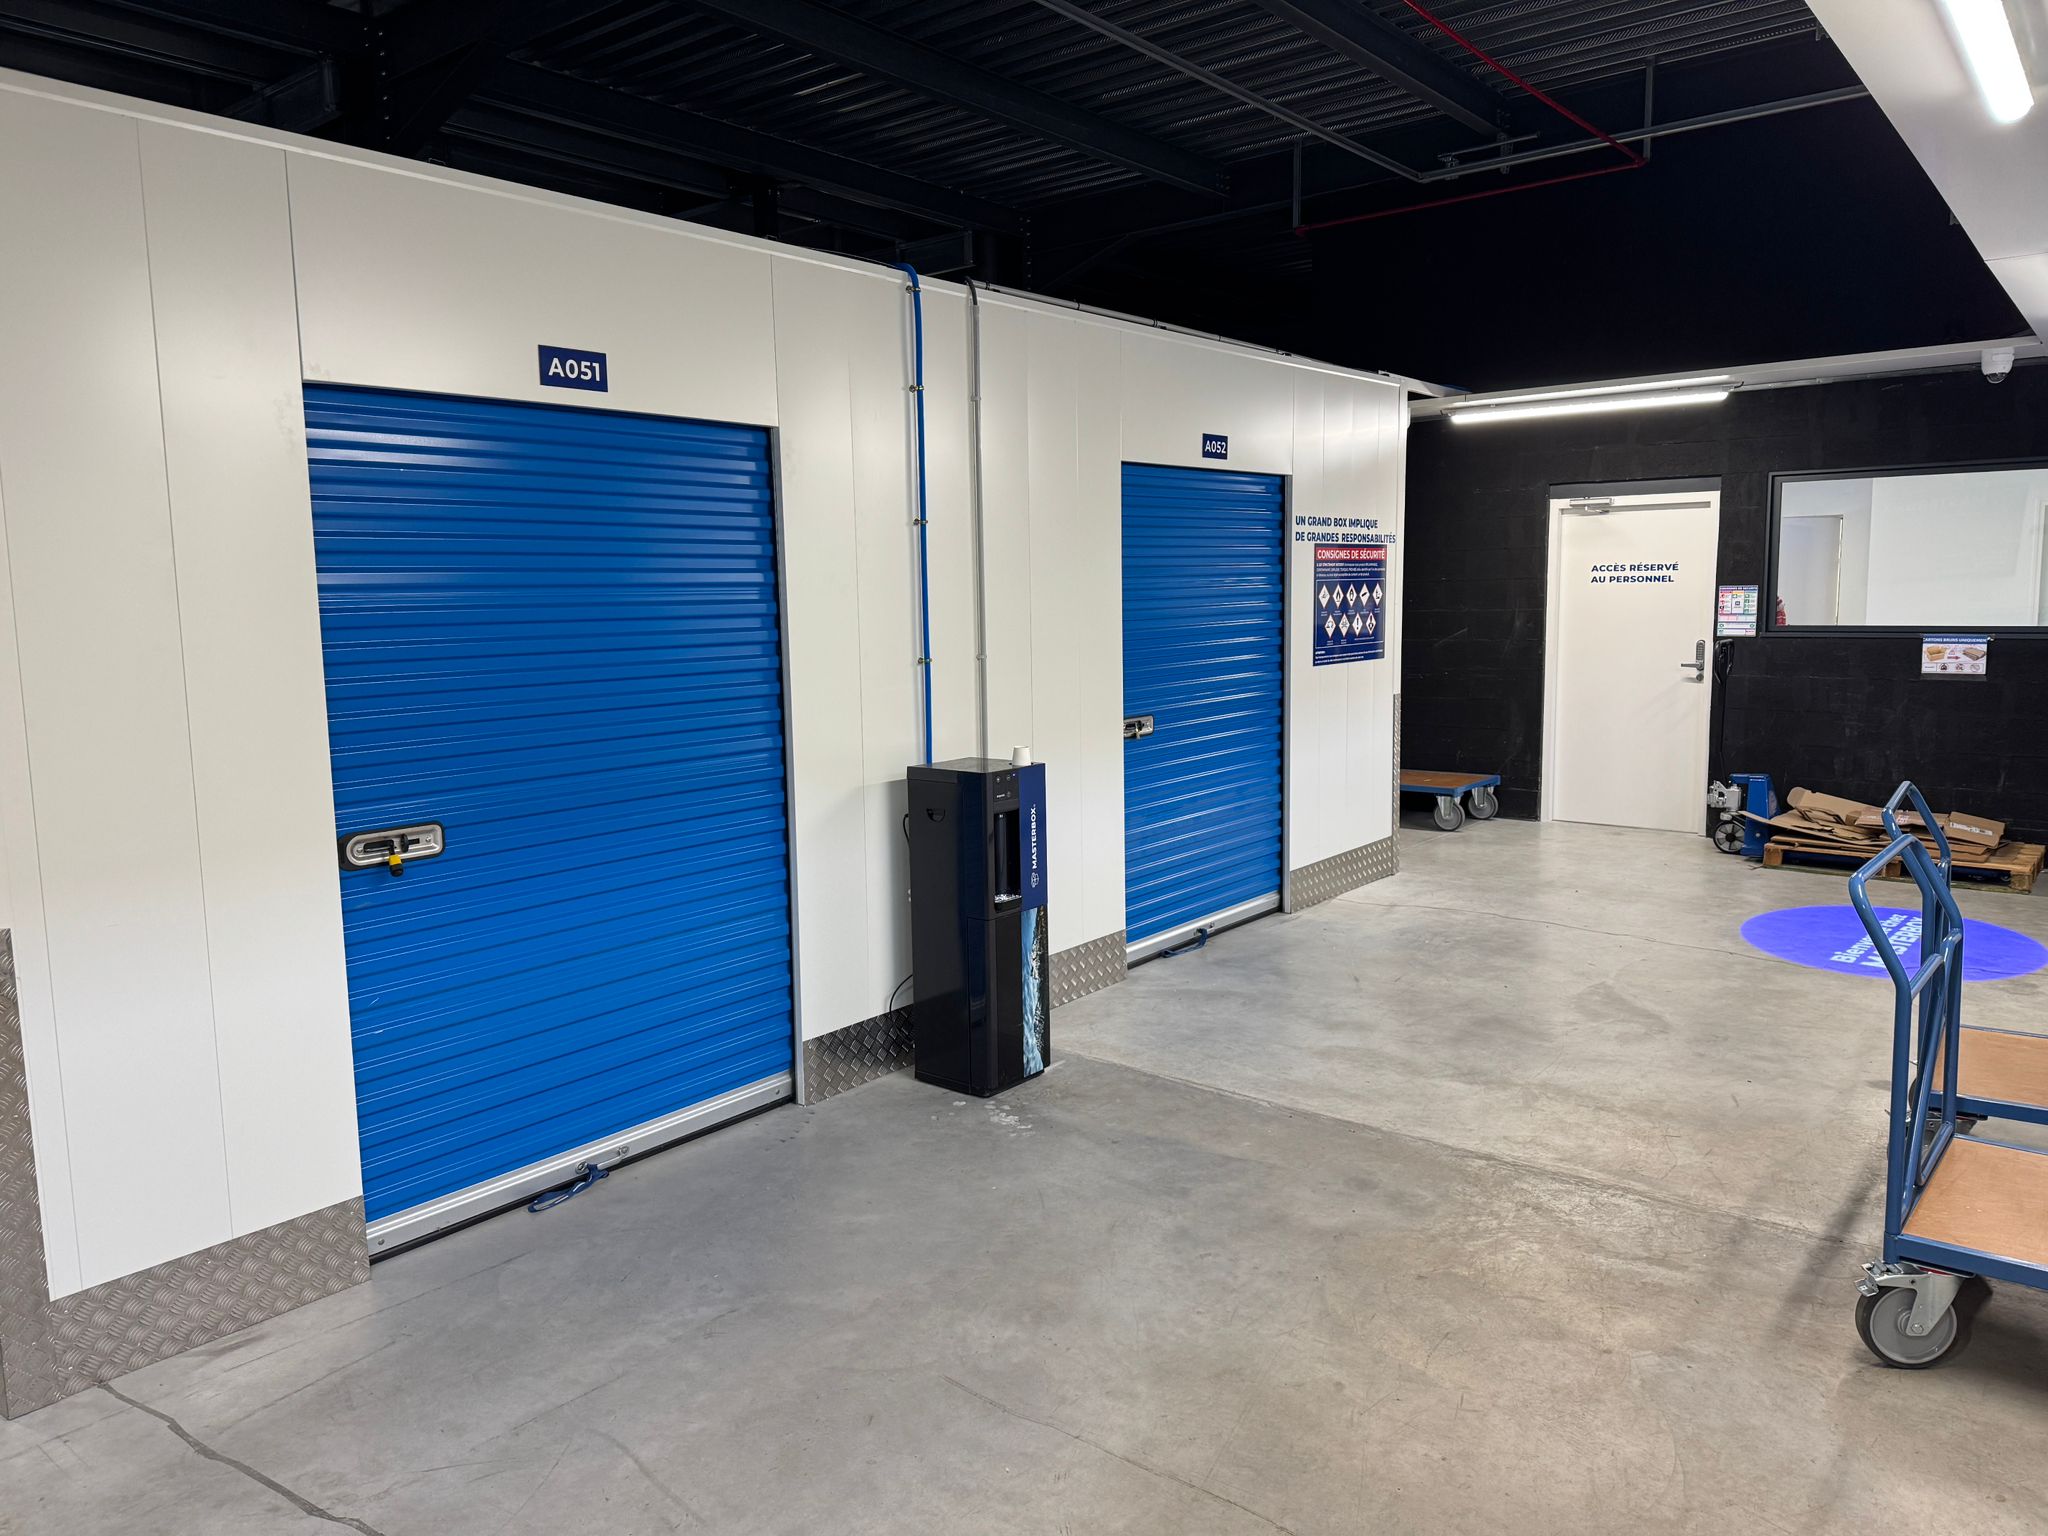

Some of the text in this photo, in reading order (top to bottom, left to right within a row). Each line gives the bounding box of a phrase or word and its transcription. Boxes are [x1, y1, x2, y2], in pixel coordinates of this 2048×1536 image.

[548, 357, 600, 382] A051
[1205, 440, 1226, 454] A052
[1295, 515, 1378, 530] UN GRAND BOX IMPLIQUE
[1295, 531, 1396, 543] DE GRANDES RESPONSABILITÉS
[1317, 548, 1385, 560] CONSIGNES DE SÉCURITÉ
[1591, 561, 1679, 572] ACCÈS RÉSERVÉ
[1591, 575, 1675, 584] AU PERSONNEL
[1030, 807, 1038, 869] MASTERBOX
[1860, 917, 1922, 968] MSTERBOX
